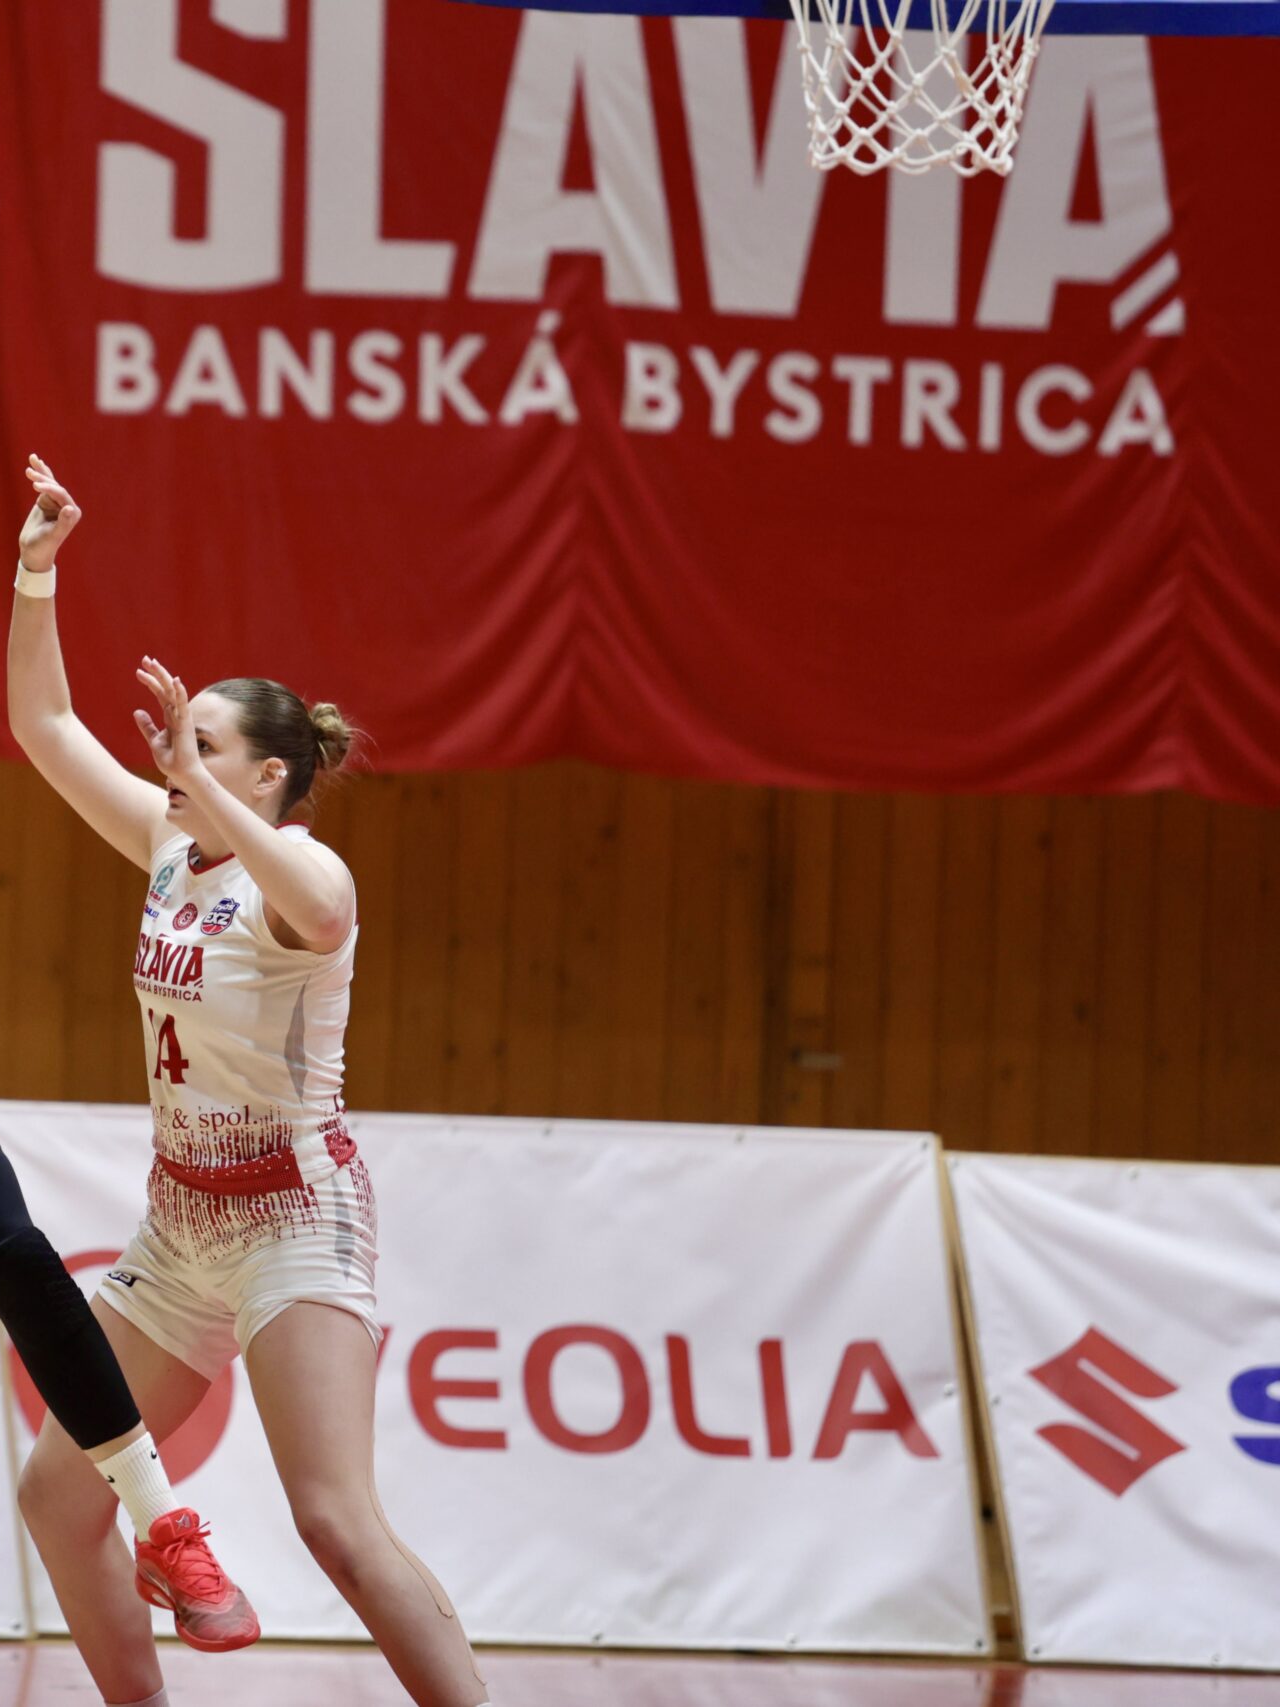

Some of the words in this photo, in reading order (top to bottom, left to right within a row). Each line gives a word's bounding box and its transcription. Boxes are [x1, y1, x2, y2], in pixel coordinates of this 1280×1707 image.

[96, 309, 580, 426] BANSKÁ
[622, 341, 1174, 457] BYSTRICA
[153, 984, 202, 1002] BYSTRICA
[172, 1108, 190, 1129] &
[198, 1105, 257, 1132] spol.
[376, 1323, 941, 1461] EOLIA
